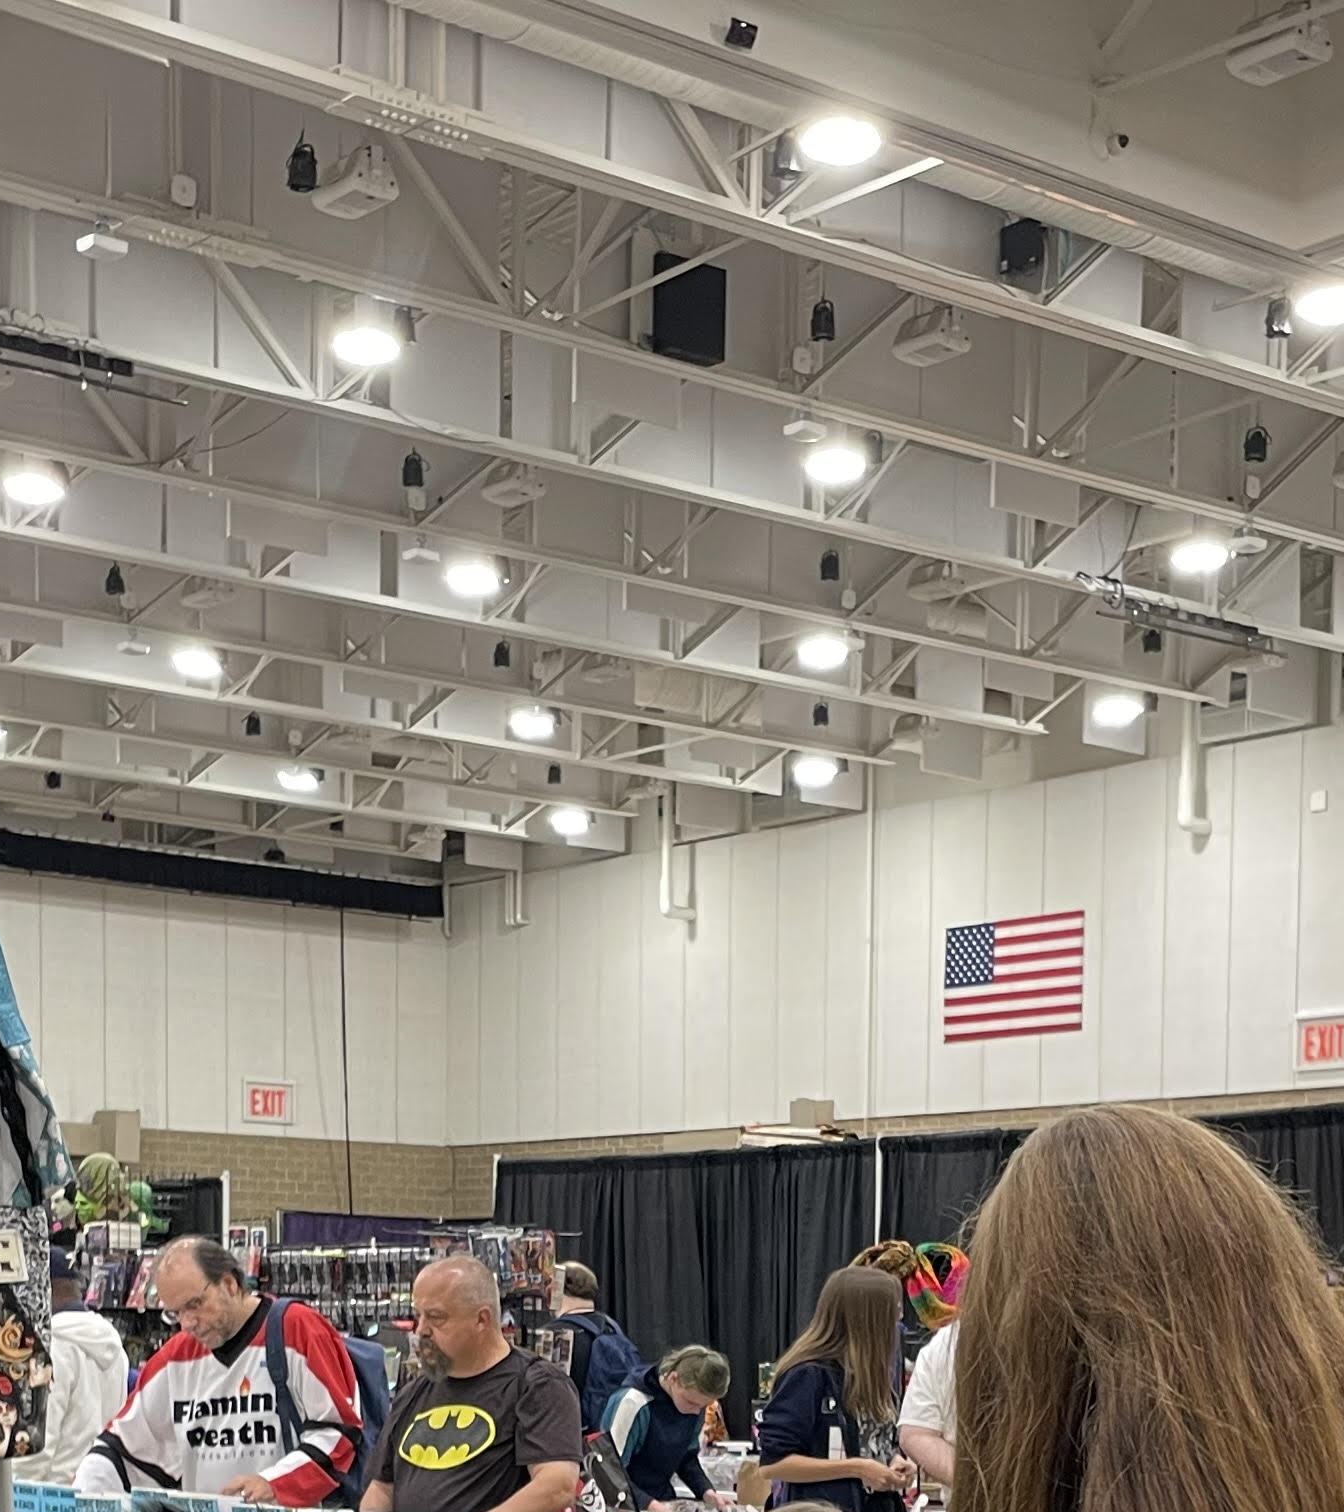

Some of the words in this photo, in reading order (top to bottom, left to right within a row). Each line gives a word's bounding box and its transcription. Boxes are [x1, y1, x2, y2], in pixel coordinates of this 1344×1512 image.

[1304, 1023, 1344, 1061] EXIT
[250, 1088, 286, 1117] EXIT
[174, 1393, 278, 1424] Flamin
[186, 1420, 276, 1449] Death
